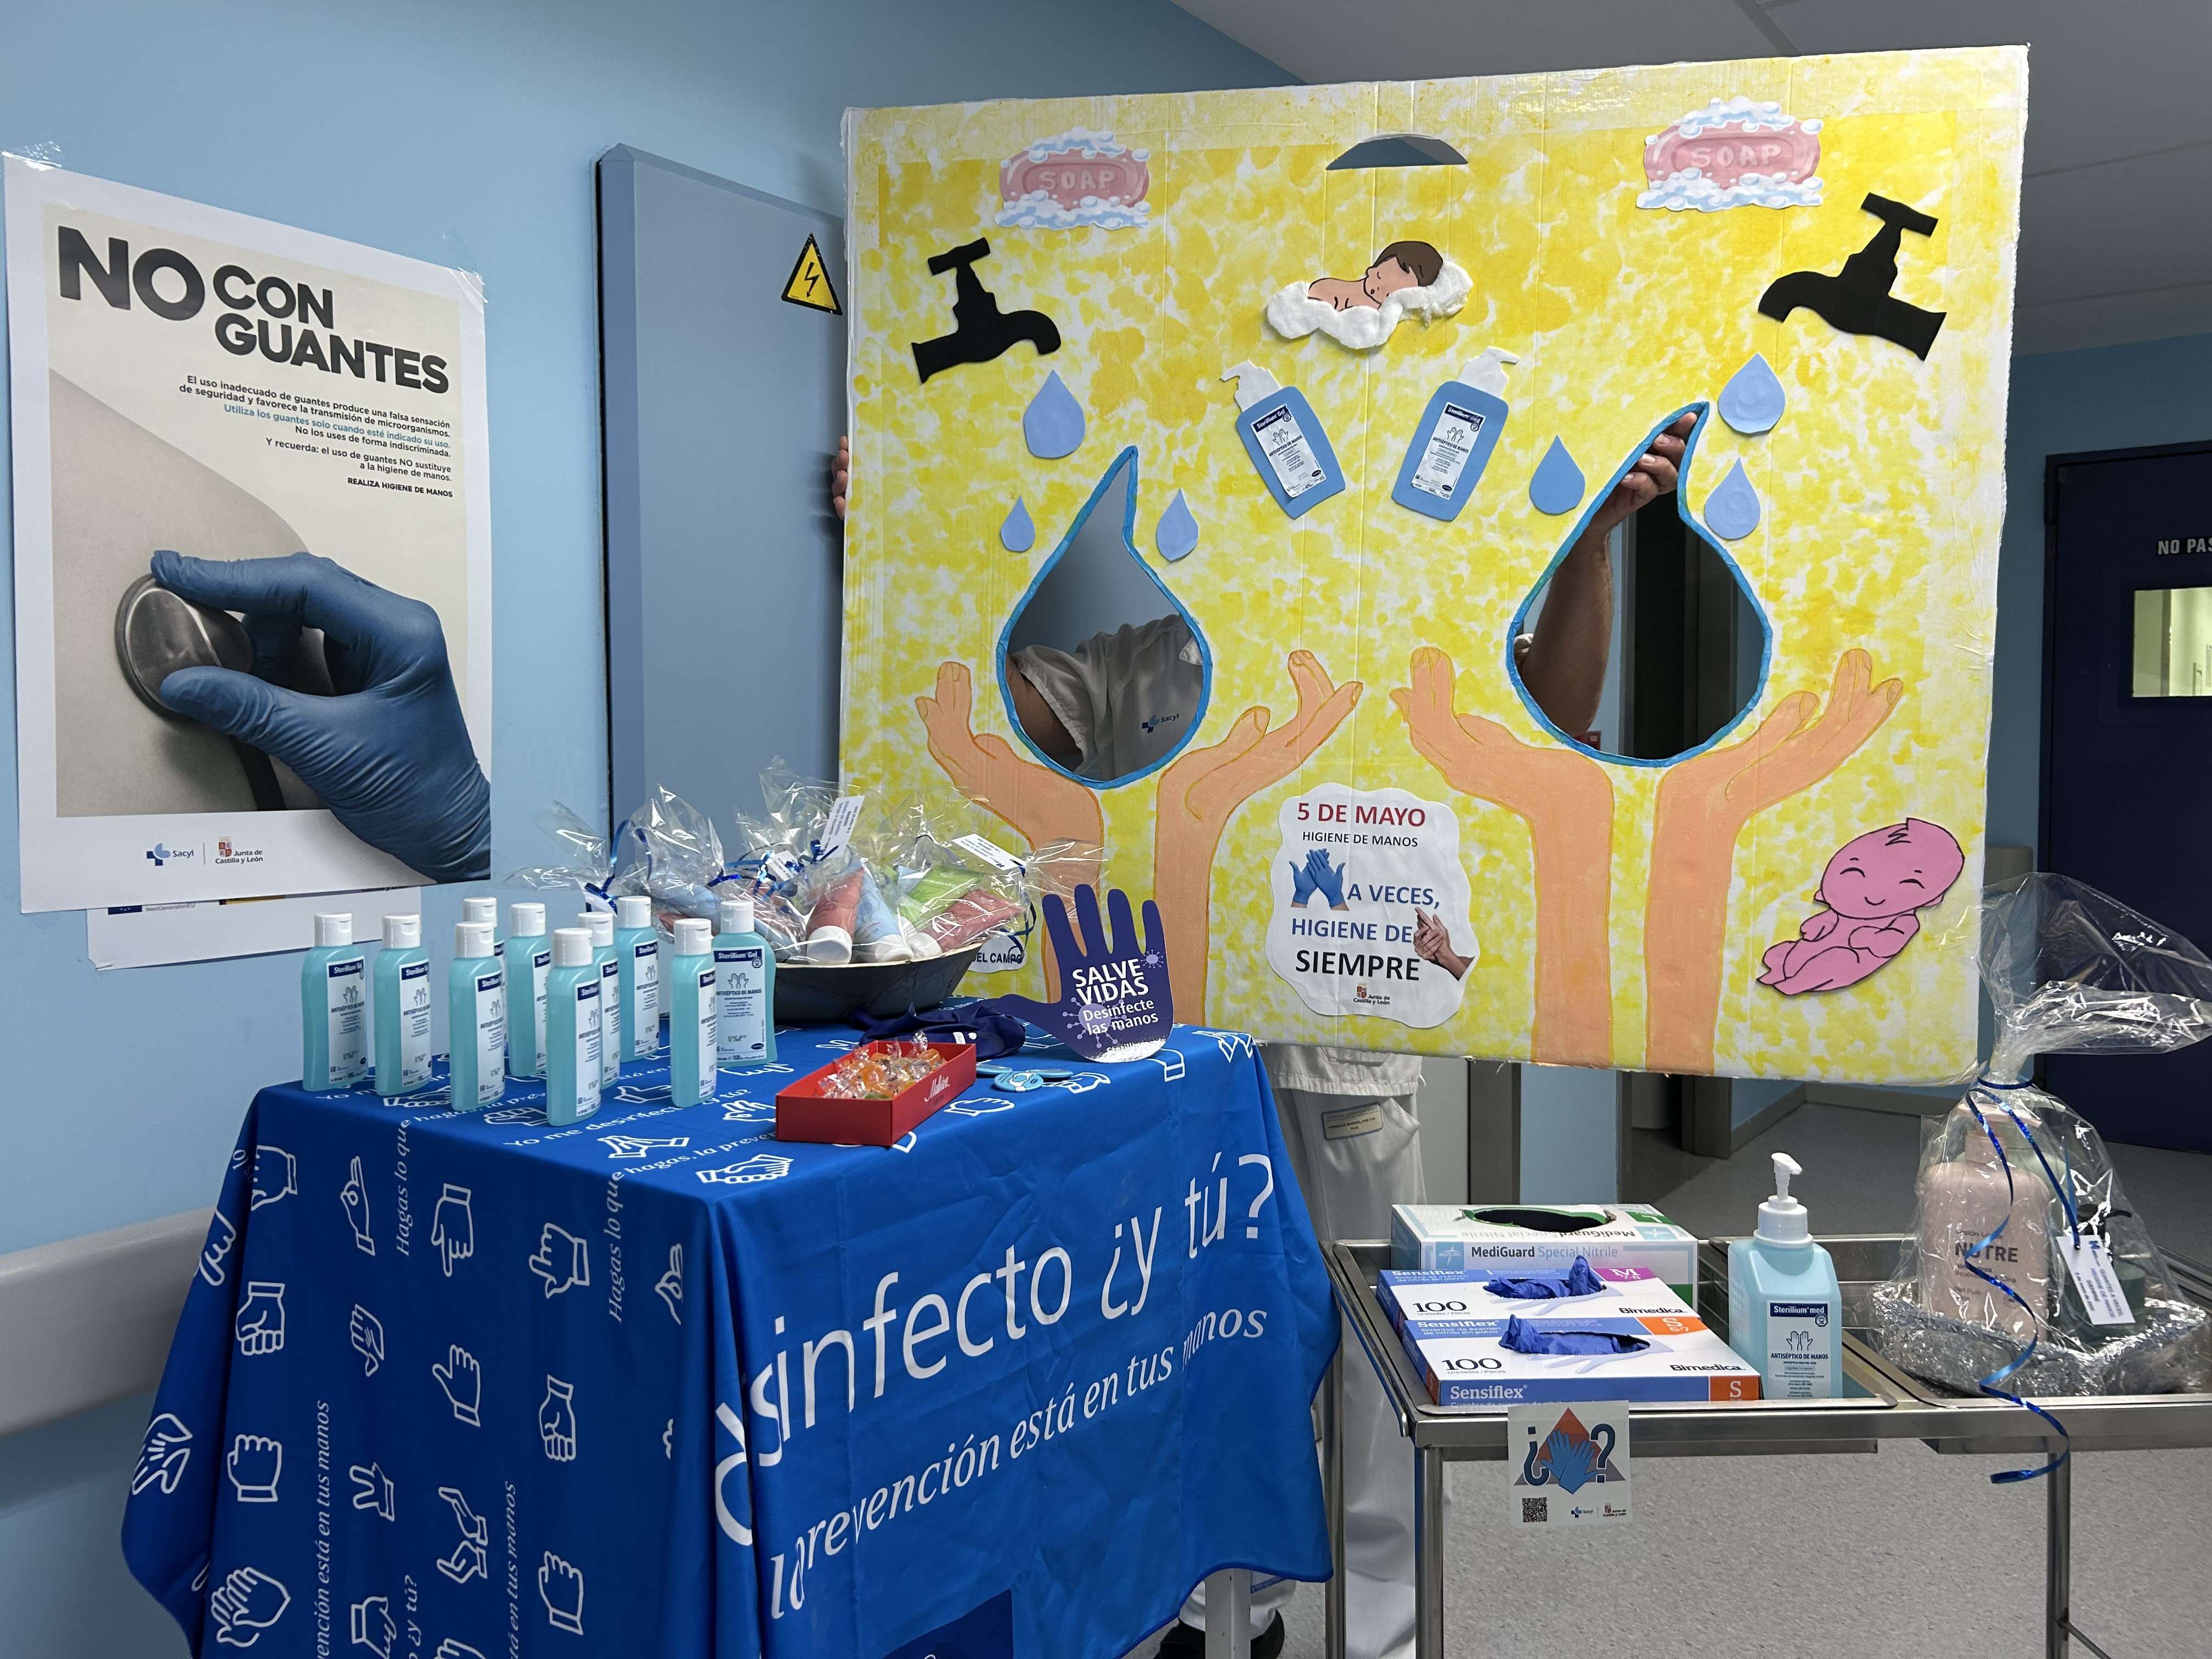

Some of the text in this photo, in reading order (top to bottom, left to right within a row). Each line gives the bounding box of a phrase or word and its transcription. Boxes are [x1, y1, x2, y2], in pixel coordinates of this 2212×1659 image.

[1691, 144, 1781, 168] SOAP
[1039, 170, 1116, 190] SOAP
[57, 225, 334, 330] NO CON
[215, 312, 449, 394] GUANTES
[179, 385, 451, 438] de seguridad y favorece la transmisión de microorganismos.
[187, 375, 450, 428] El uso inadecuado de guantes produce una falsa sensación
[224, 404, 451, 449] Utiliza los guantes solo cuando esté indicado su uso.
[295, 426, 451, 458] No los uses de forma indiscriminada.
[266, 437, 273, 445] Y
[275, 439, 319, 453] recuerda:
[332, 449, 348, 457] uso
[350, 450, 361, 459] de
[363, 454, 397, 465] guantes
[399, 458, 413, 467] NO
[415, 461, 452, 472] sustituye
[367, 462, 375, 471] la
[377, 462, 409, 475] higiene
[423, 472, 452, 482] manos.
[347, 477, 380, 488] REALIZA
[382, 482, 413, 492] HIGIENE
[426, 488, 453, 498] MANOS
[2158, 539, 2180, 555] NO
[1161, 713, 1180, 723] Sacyl
[1297, 803, 1426, 827] 5 DE MAYO
[1302, 831, 1418, 848] HIGIENE DE MANOS
[172, 849, 194, 859] Sacyl
[234, 849, 253, 857] Junta
[246, 855, 263, 864] León
[1347, 883, 1440, 910] A VECES,
[1292, 918, 1413, 944] HIGIENE DE
[1072, 958, 1144, 988] SALVE
[1295, 950, 1420, 981] SIEMPRE
[1076, 976, 1149, 1005] VIDAS
[1082, 1000, 1155, 1022] Desinfecte
[1087, 1013, 1159, 1035] las manos
[503, 1138, 540, 1148] Yo
[543, 1129, 583, 1141] me
[693, 1147, 718, 1156] la
[394, 1160, 408, 1182] lo
[624, 1154, 697, 1175] hagas,
[396, 1184, 414, 1257] Hagas
[603, 1218, 622, 1240] lo
[1101, 1206, 1162, 1319] ¿y
[1184, 1150, 1274, 1260] tú?
[1471, 1246, 1618, 1260] MediGuard Special Nitrile
[608, 1243, 626, 1324] Hagas
[1413, 1301, 1467, 1313] 100
[1774, 1305, 1825, 1314] Sterillium med
[1662, 1318, 1683, 1327] S
[1442, 1358, 1502, 1370] 100
[1729, 1380, 1742, 1398] S
[807, 1432, 999, 1570] revención
[1011, 1381, 1075, 1460] está
[1083, 1371, 1118, 1420] en
[1127, 1344, 1172, 1398] tus
[1182, 1308, 1268, 1374] manos
[314, 1400, 330, 1584] está en tus manos
[504, 1481, 519, 1631] en tus manos
[404, 1574, 417, 1612] tú?
[408, 1619, 422, 1647] ¿y
